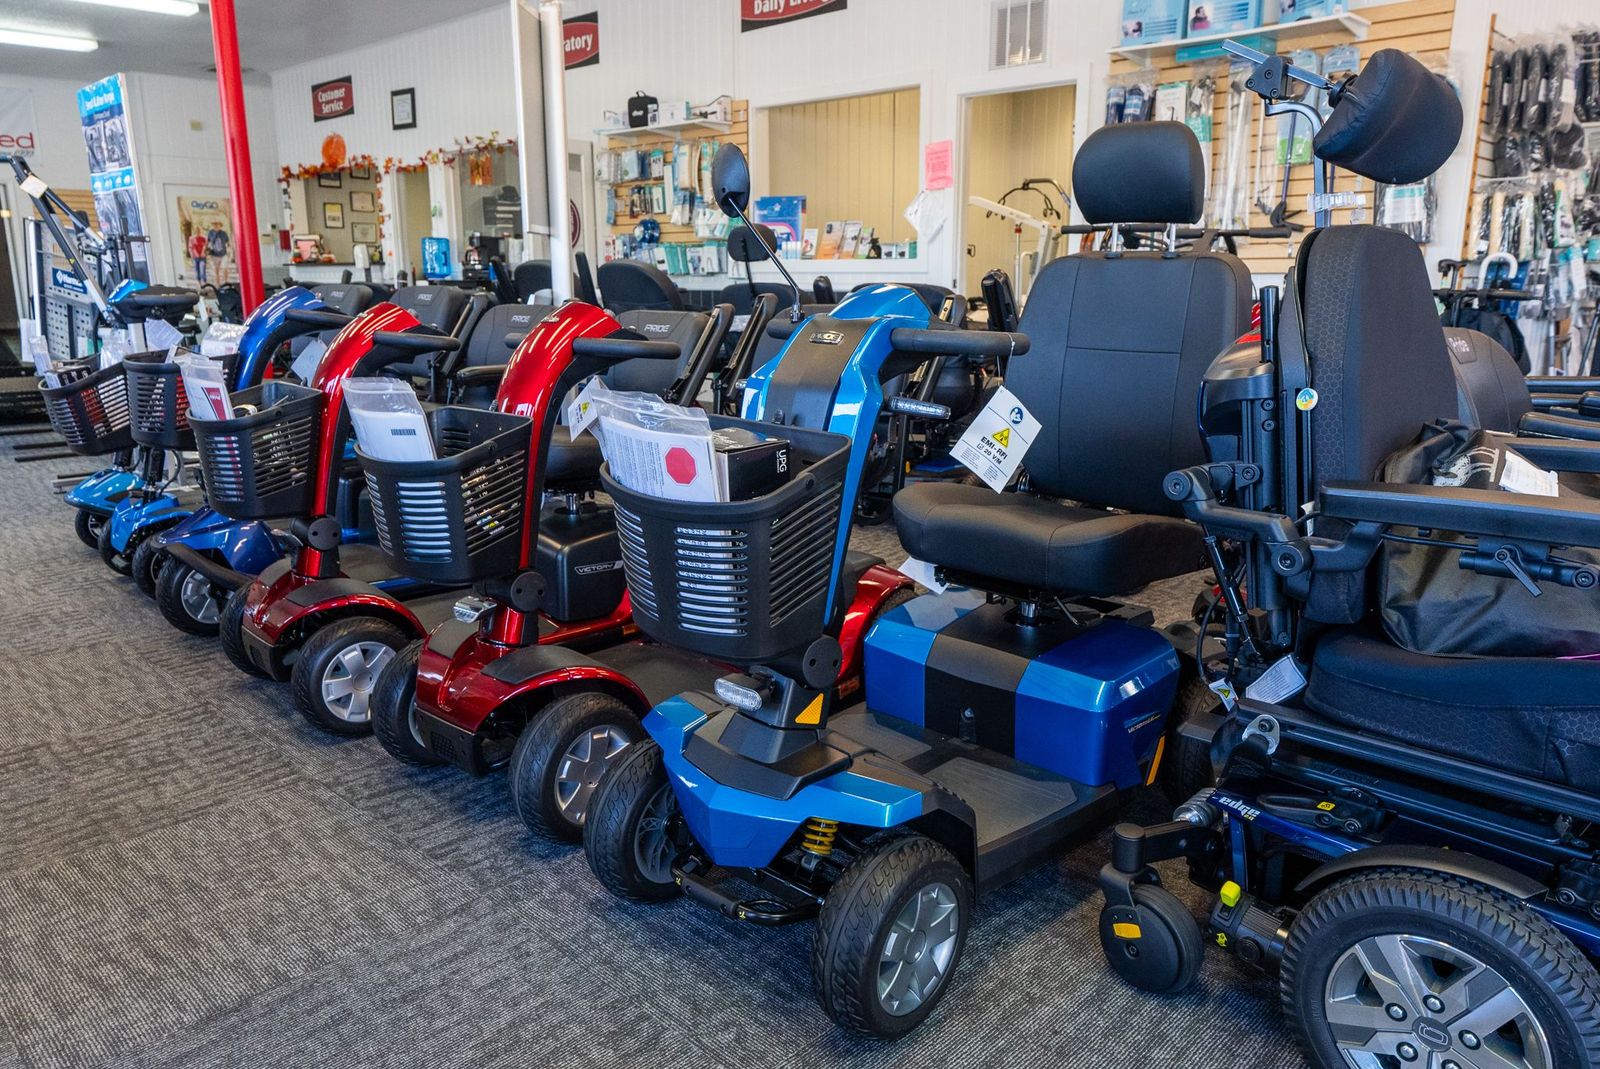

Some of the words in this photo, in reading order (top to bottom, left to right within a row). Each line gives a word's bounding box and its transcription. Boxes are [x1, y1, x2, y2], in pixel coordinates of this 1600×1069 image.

[563, 33, 593, 52] atory
[318, 87, 345, 103] Customer
[321, 100, 343, 114] Service
[511, 314, 531, 323] PRIDE
[643, 323, 671, 333] PRIDE
[778, 449, 787, 473] UPG
[578, 564, 614, 573] VICTORY
[1218, 796, 1261, 817] edge
